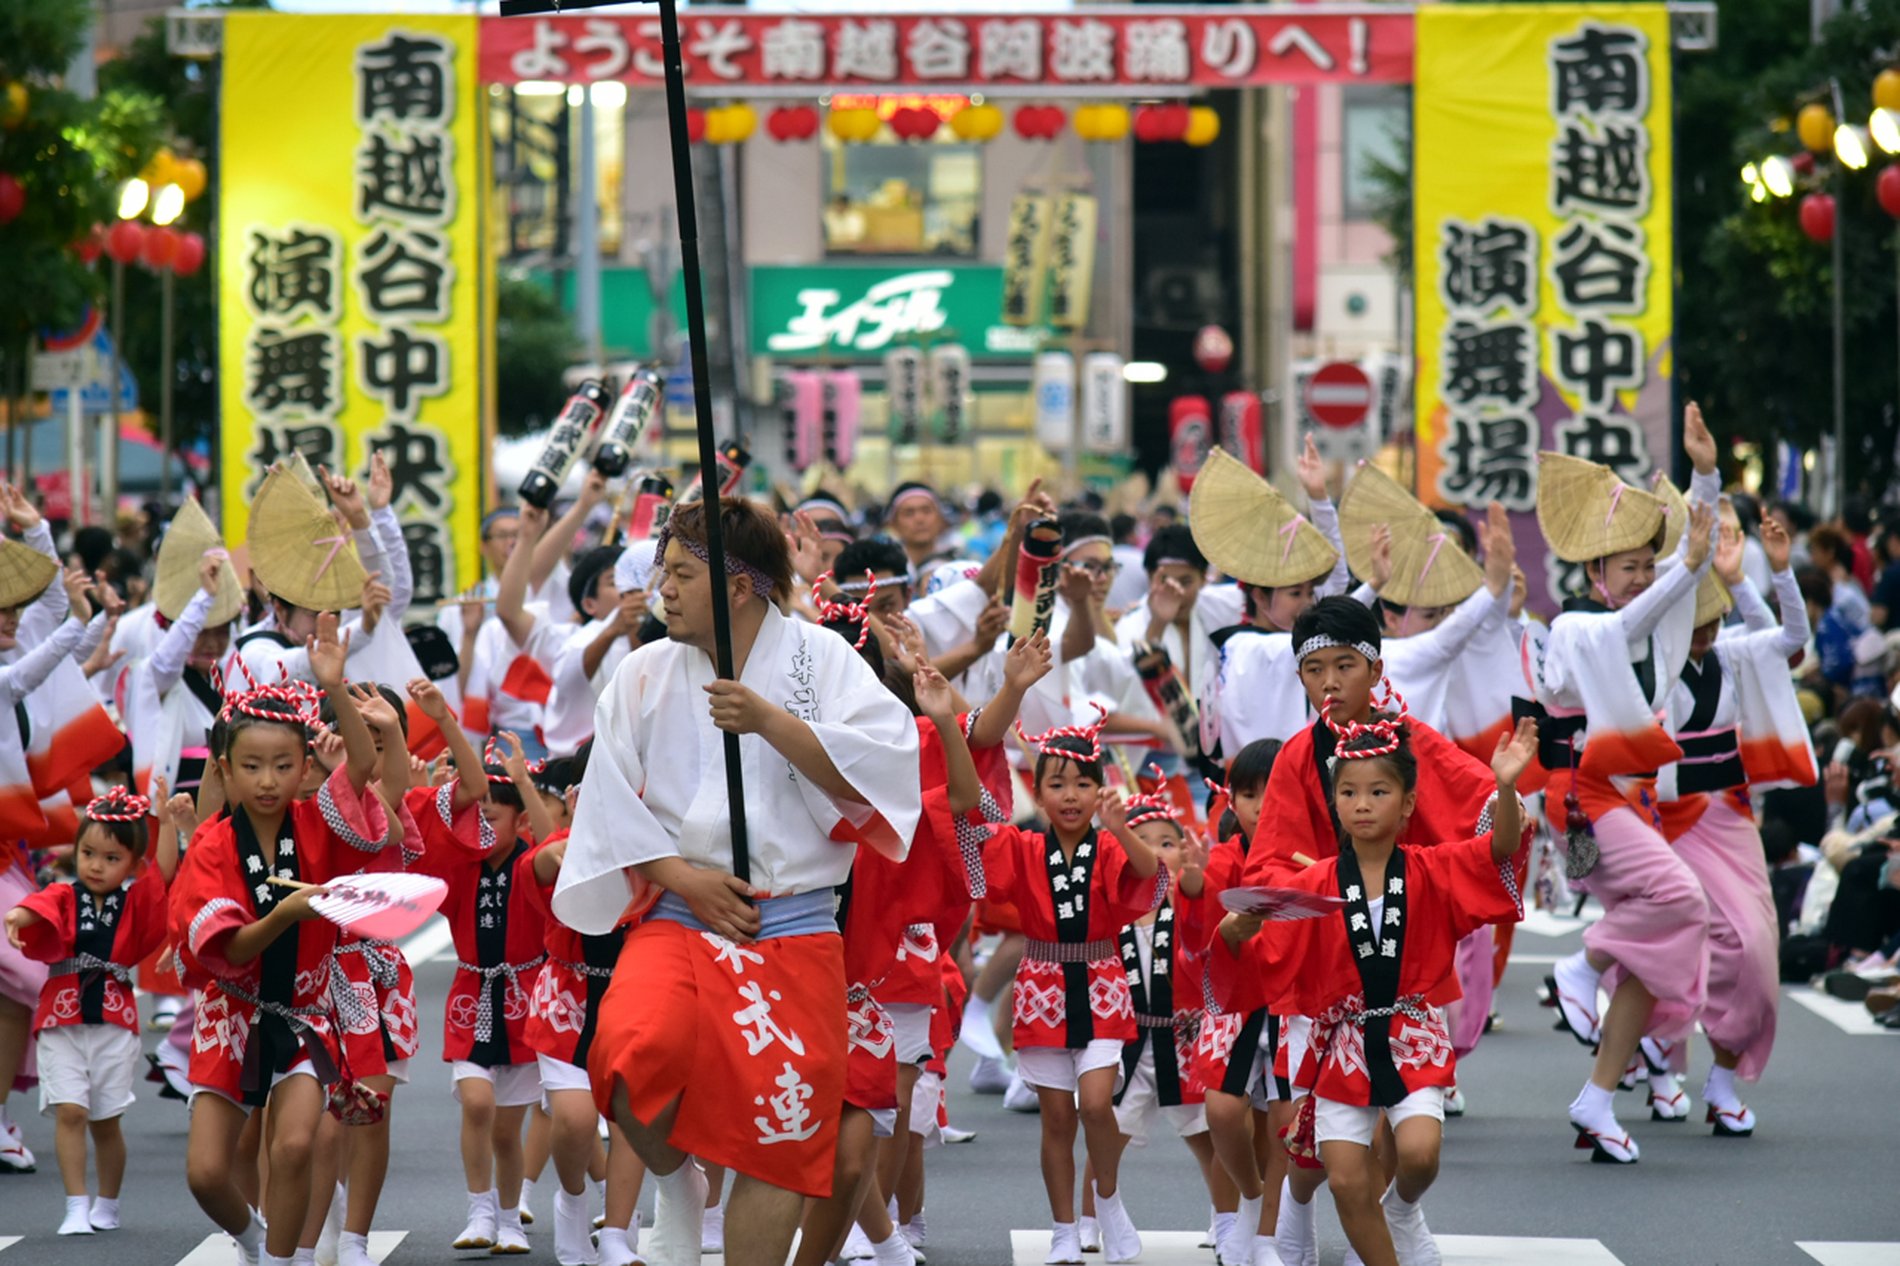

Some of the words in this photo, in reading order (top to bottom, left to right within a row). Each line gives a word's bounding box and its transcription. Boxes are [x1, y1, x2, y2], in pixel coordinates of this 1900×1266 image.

[1445, 222, 1533, 503] 演舞場
[1345, 884, 1375, 960] 東武連
[1381, 876, 1405, 958] 東武連
